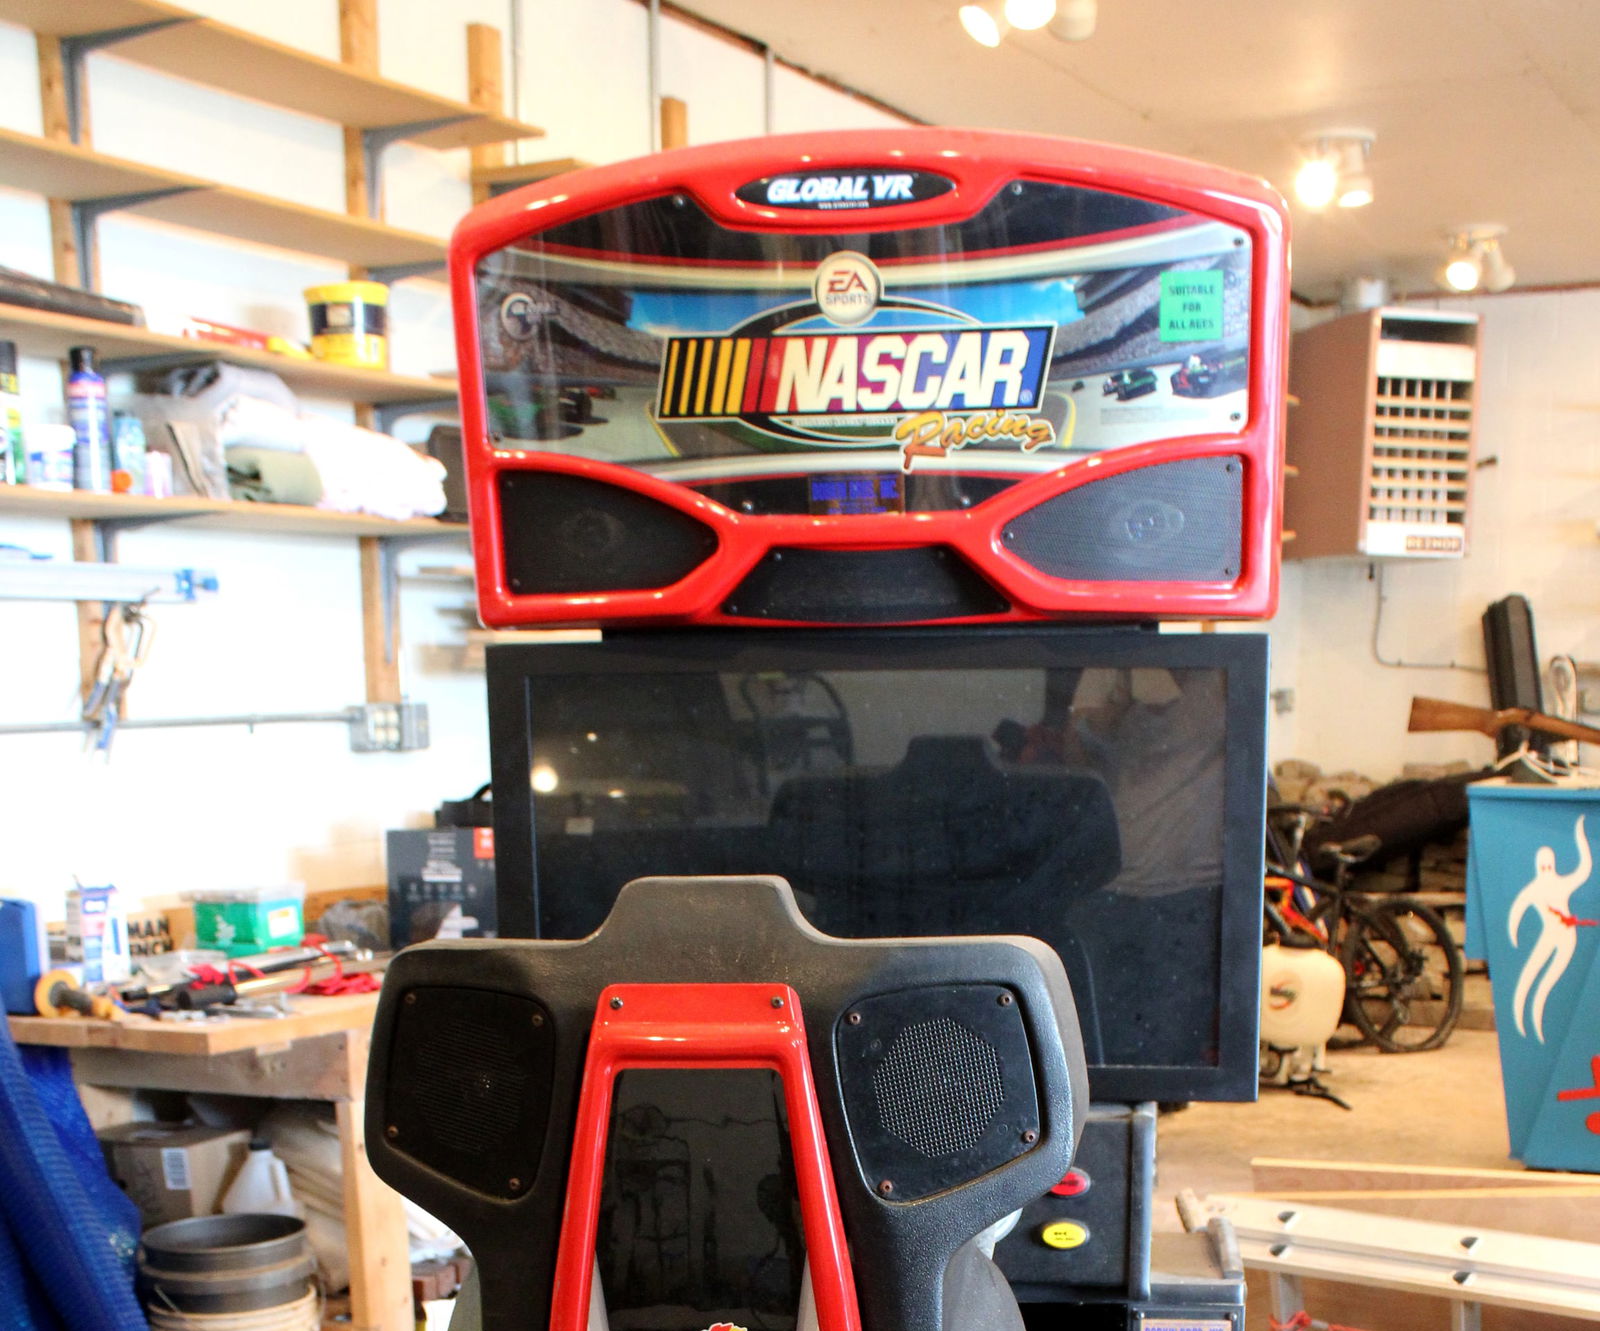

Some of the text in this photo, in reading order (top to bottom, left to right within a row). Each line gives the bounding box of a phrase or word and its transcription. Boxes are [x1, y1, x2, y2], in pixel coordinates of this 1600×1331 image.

[767, 174, 914, 203] GLOBAL VR
[828, 271, 867, 293] EA
[1168, 284, 1215, 296] SUITABLE
[826, 293, 872, 305] SPORTS
[1182, 302, 1202, 313] FOR
[1168, 319, 1214, 330] ALL AGES
[776, 330, 1030, 413] NASCAR
[896, 410, 1054, 471] Racing
